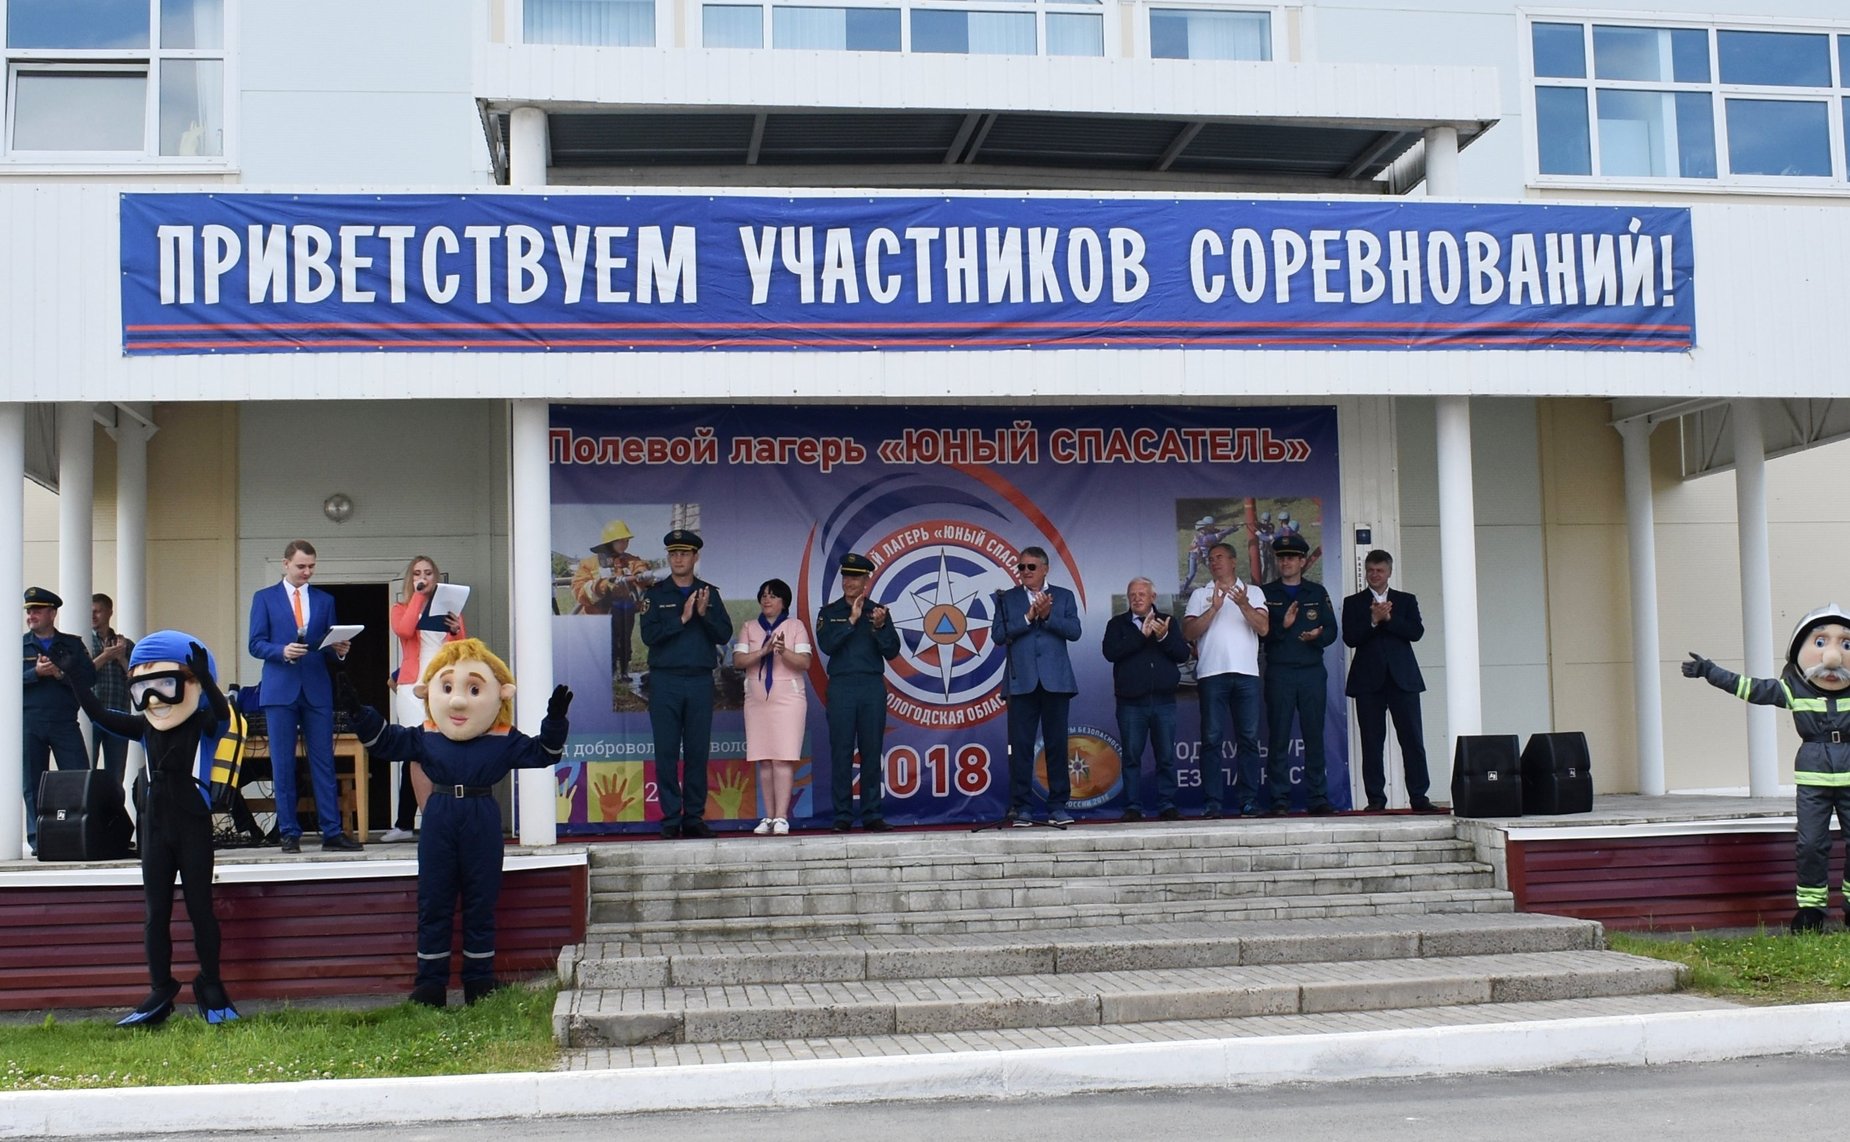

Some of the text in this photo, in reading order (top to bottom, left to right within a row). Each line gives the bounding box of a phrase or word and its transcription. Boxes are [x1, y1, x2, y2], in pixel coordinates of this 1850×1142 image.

[156, 216, 1675, 307] ПРИВЕТСТВУЕМ УЧАСТНИКОВ СОРЕВНОВАНИЙ!
[549, 420, 1312, 473] Полевой лагерь «ЮНЫЙ СПАСАТЕЛЬ»
[882, 527, 930, 558] ЛАГЕРЬ
[934, 525, 987, 546] «ЮНЫЙ
[886, 692, 1007, 726] ОЛОГОДСКАЯ ОБЛАС
[574, 740, 684, 758] добровол
